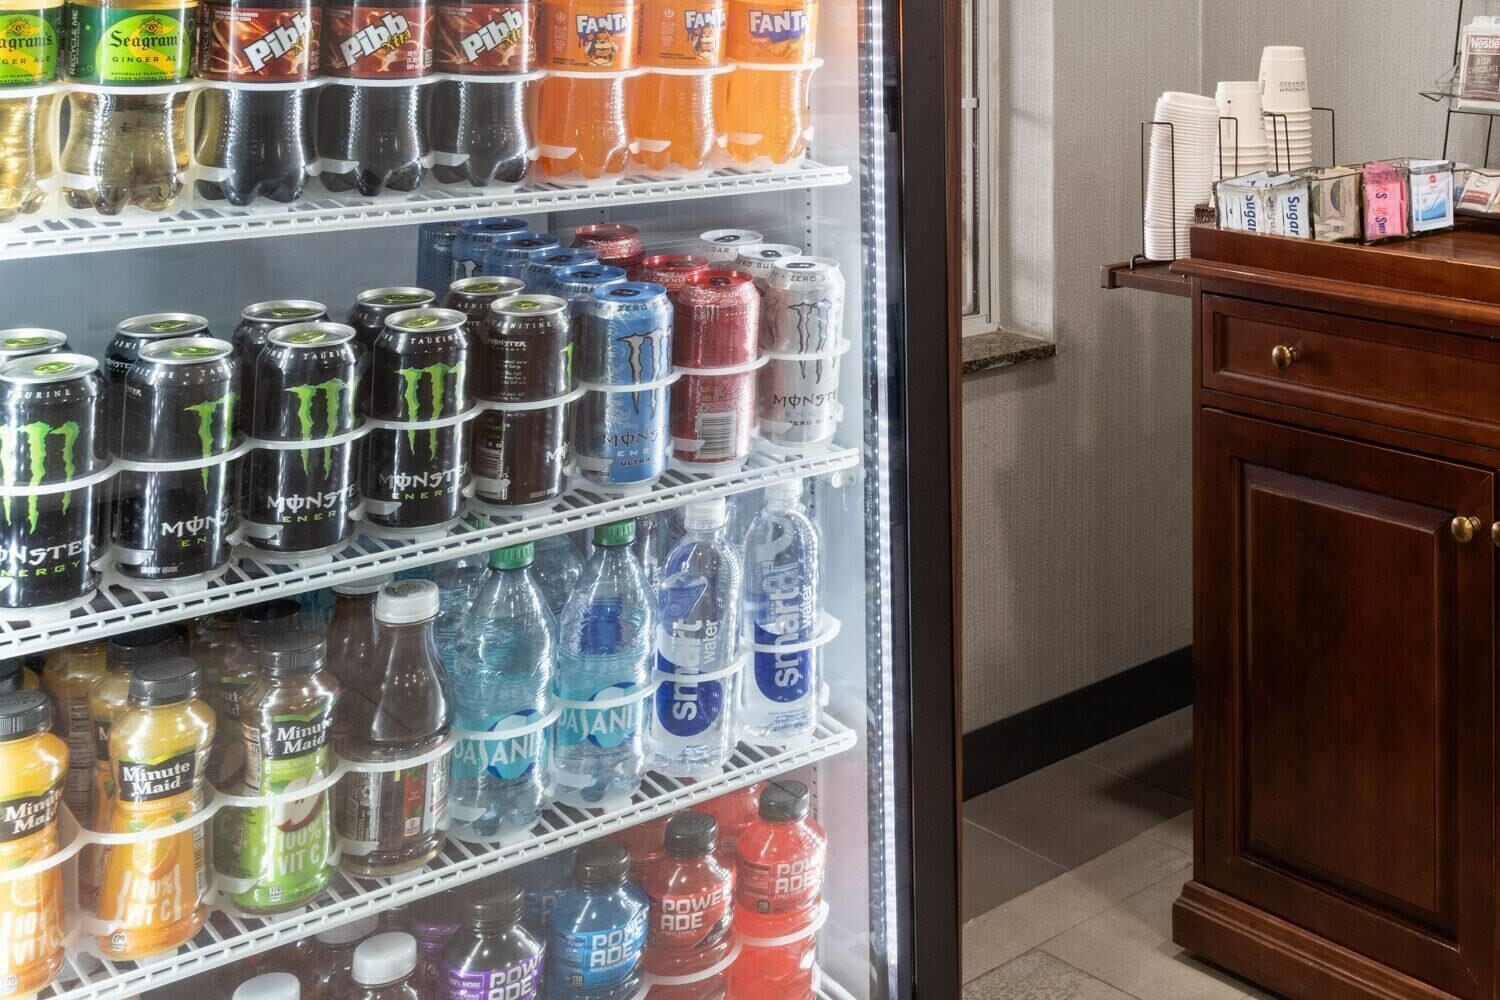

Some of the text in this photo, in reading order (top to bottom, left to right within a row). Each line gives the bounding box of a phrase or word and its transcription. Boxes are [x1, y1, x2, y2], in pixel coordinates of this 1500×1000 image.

[0, 32, 54, 52] agram's
[69, 9, 79, 76] RECYCLE ME
[241, 12, 313, 73] Pibb
[340, 13, 409, 68] Pibb
[461, 9, 524, 63] Pibb
[1467, 64, 1500, 74] CHOCOLATE
[1476, 55, 1492, 66] RICH
[1243, 194, 1257, 233] Sugar
[1285, 195, 1301, 236] Sugar
[756, 262, 776, 270] SUG
[617, 303, 648, 312] ZERO
[603, 429, 659, 448] MONS
[617, 447, 651, 457] ENE
[379, 461, 468, 490] MONSTE
[620, 458, 651, 466] ULTRA
[267, 485, 357, 514] MONSTE
[392, 483, 463, 500] ENERG
[160, 509, 231, 538] MONS
[282, 504, 338, 524] ENER
[0, 534, 96, 566] NSTER
[0, 560, 81, 578] NERGY
[801, 584, 815, 630] water
[703, 618, 719, 665] water
[559, 706, 633, 742] DASANI
[281, 729, 327, 755] Maid
[454, 734, 535, 773] DASANI
[122, 762, 191, 782] Minute
[131, 775, 181, 796] Maid
[4, 786, 64, 823] Minu
[279, 820, 321, 854] 100%
[277, 843, 320, 876] VIT C
[776, 857, 820, 877] POW
[161, 898, 171, 921] C
[660, 911, 704, 931] ADE
[592, 915, 643, 951] POWE
[489, 948, 545, 989] POWE
[590, 941, 633, 968] ADE
[488, 974, 533, 1000] ADE
